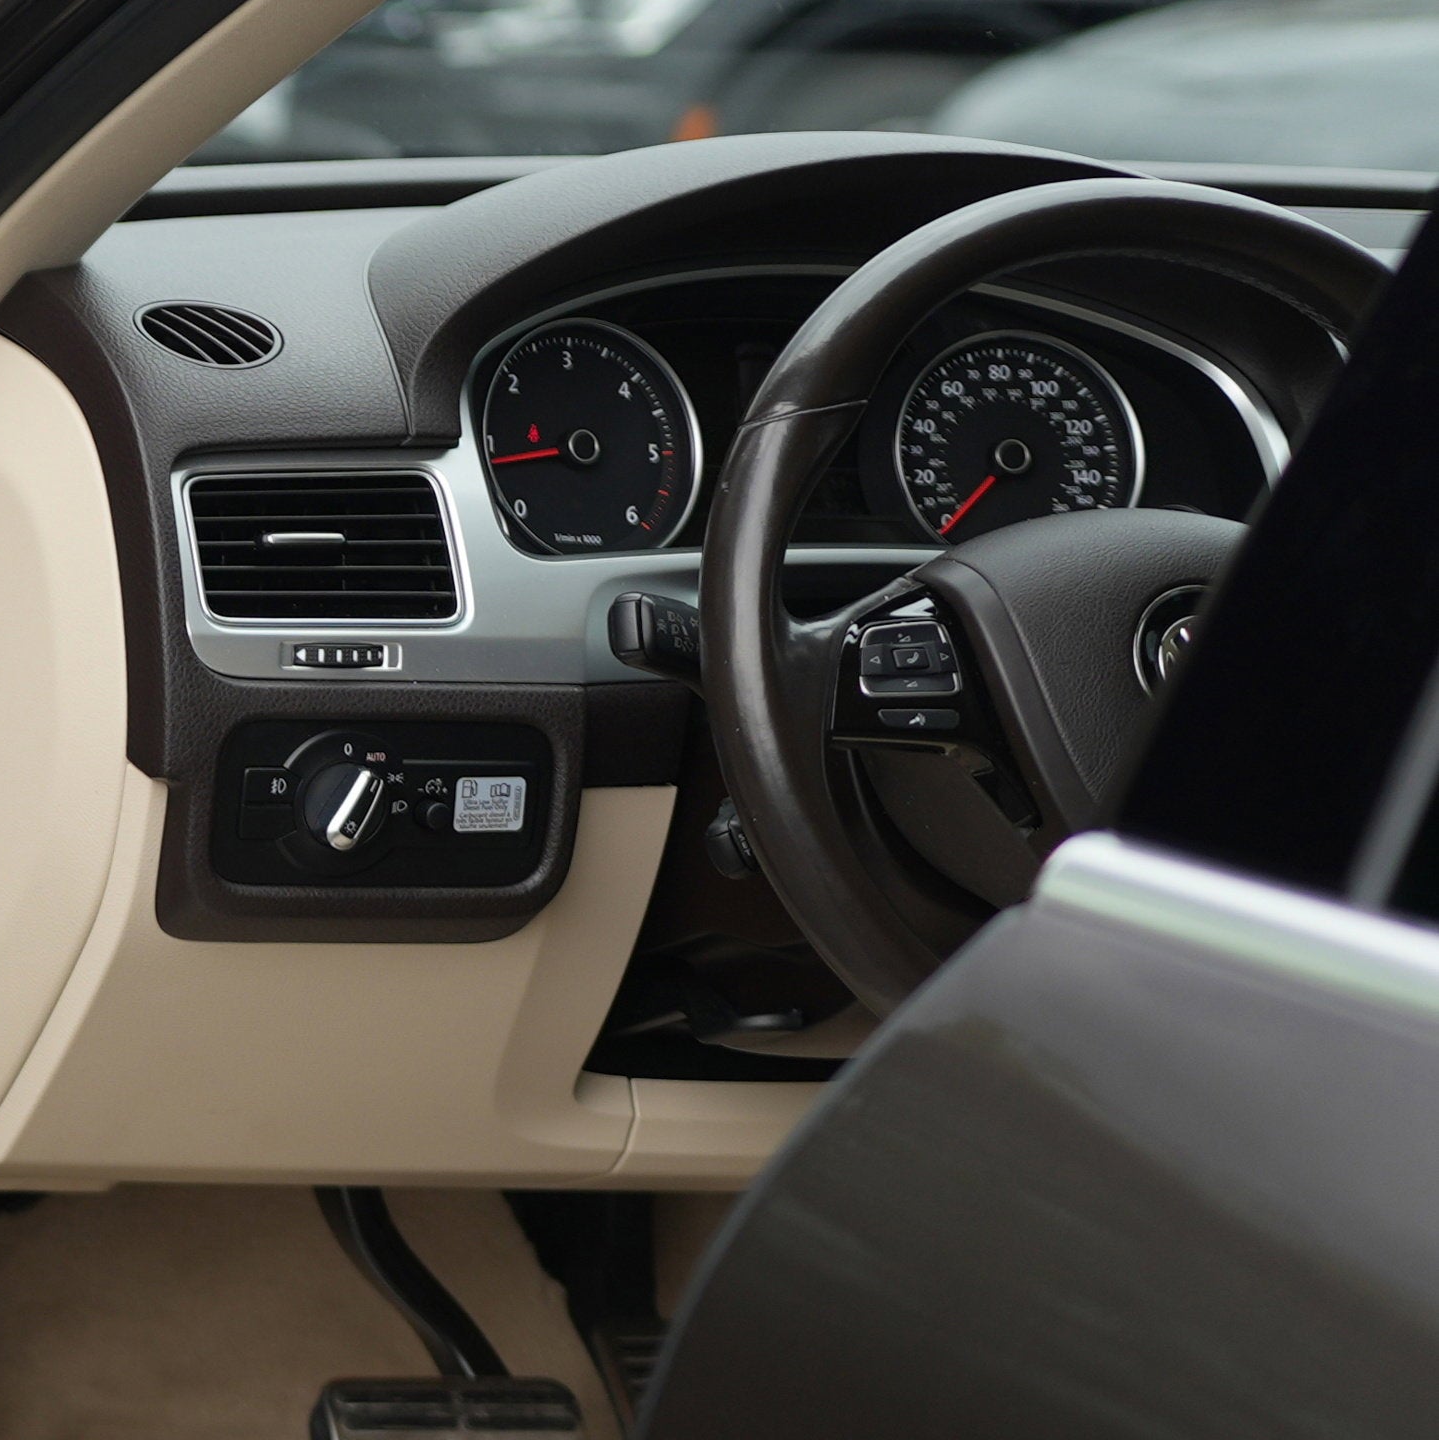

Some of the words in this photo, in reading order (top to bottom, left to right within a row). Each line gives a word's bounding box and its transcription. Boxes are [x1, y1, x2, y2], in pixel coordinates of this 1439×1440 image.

[562, 351, 573, 370] 3
[967, 368, 981, 381] 70
[988, 364, 1011, 382] 80
[1017, 368, 1034, 381] 90
[508, 374, 521, 395] 2
[618, 381, 632, 401] 4
[941, 380, 965, 397] 60
[1030, 380, 1060, 398] 100
[926, 399, 940, 411] 50
[913, 418, 936, 435] 40
[1064, 419, 1094, 437] 120
[486, 435, 495, 454] 1
[648, 443, 660, 463] 5
[909, 445, 923, 455] 30
[914, 469, 936, 485] 20
[1071, 469, 1103, 487] 140
[514, 499, 527, 518] 0
[626, 505, 639, 525] 6
[344, 743, 353, 756] 0
[366, 752, 387, 762] AUTO
